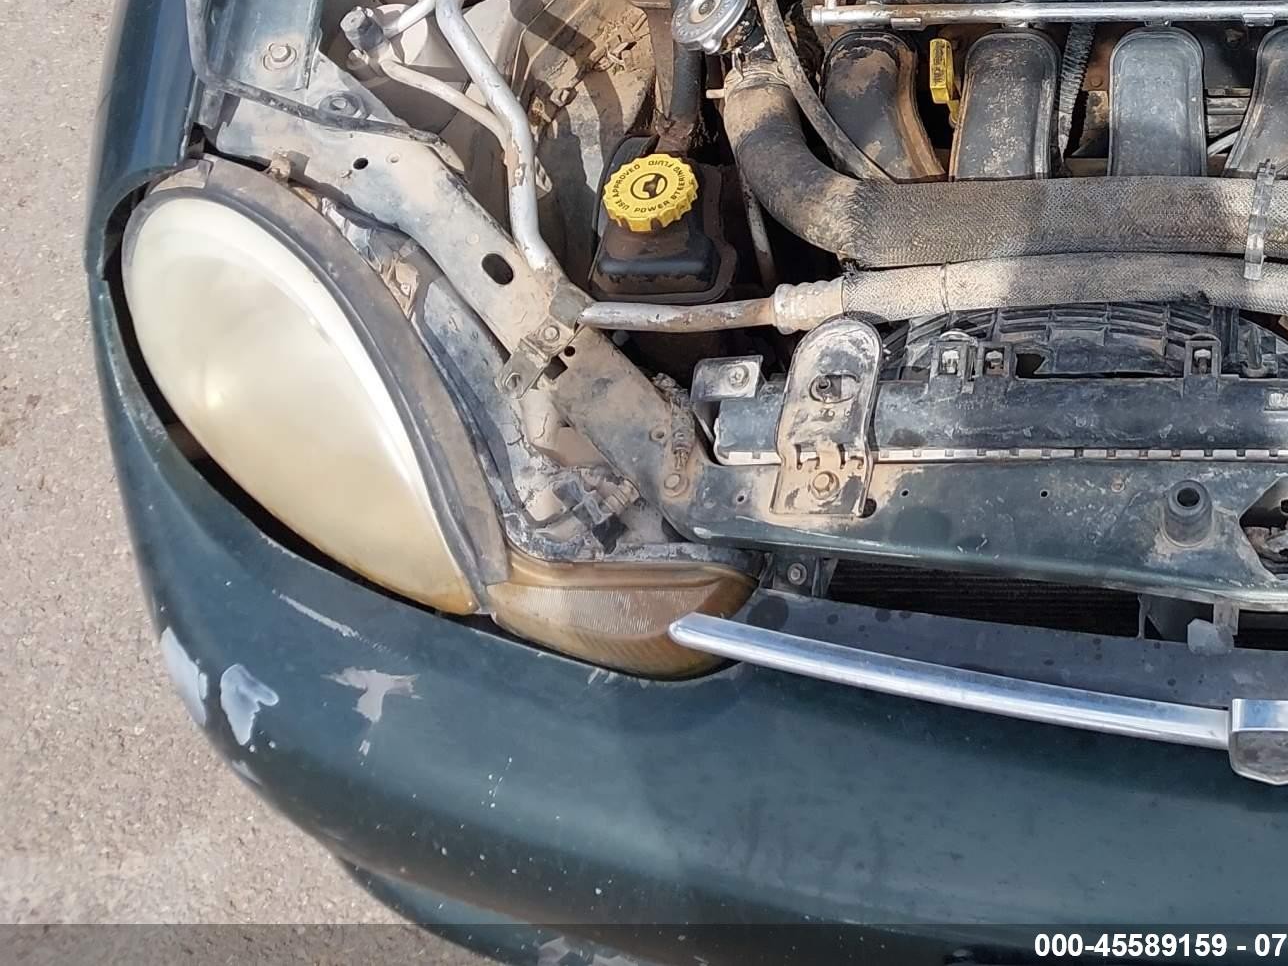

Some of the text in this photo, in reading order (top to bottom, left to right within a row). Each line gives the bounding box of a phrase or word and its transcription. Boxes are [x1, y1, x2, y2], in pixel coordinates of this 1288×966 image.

[648, 160, 675, 169] FLUID
[612, 164, 641, 211] USE APPROVED
[633, 200, 671, 213] POWER
